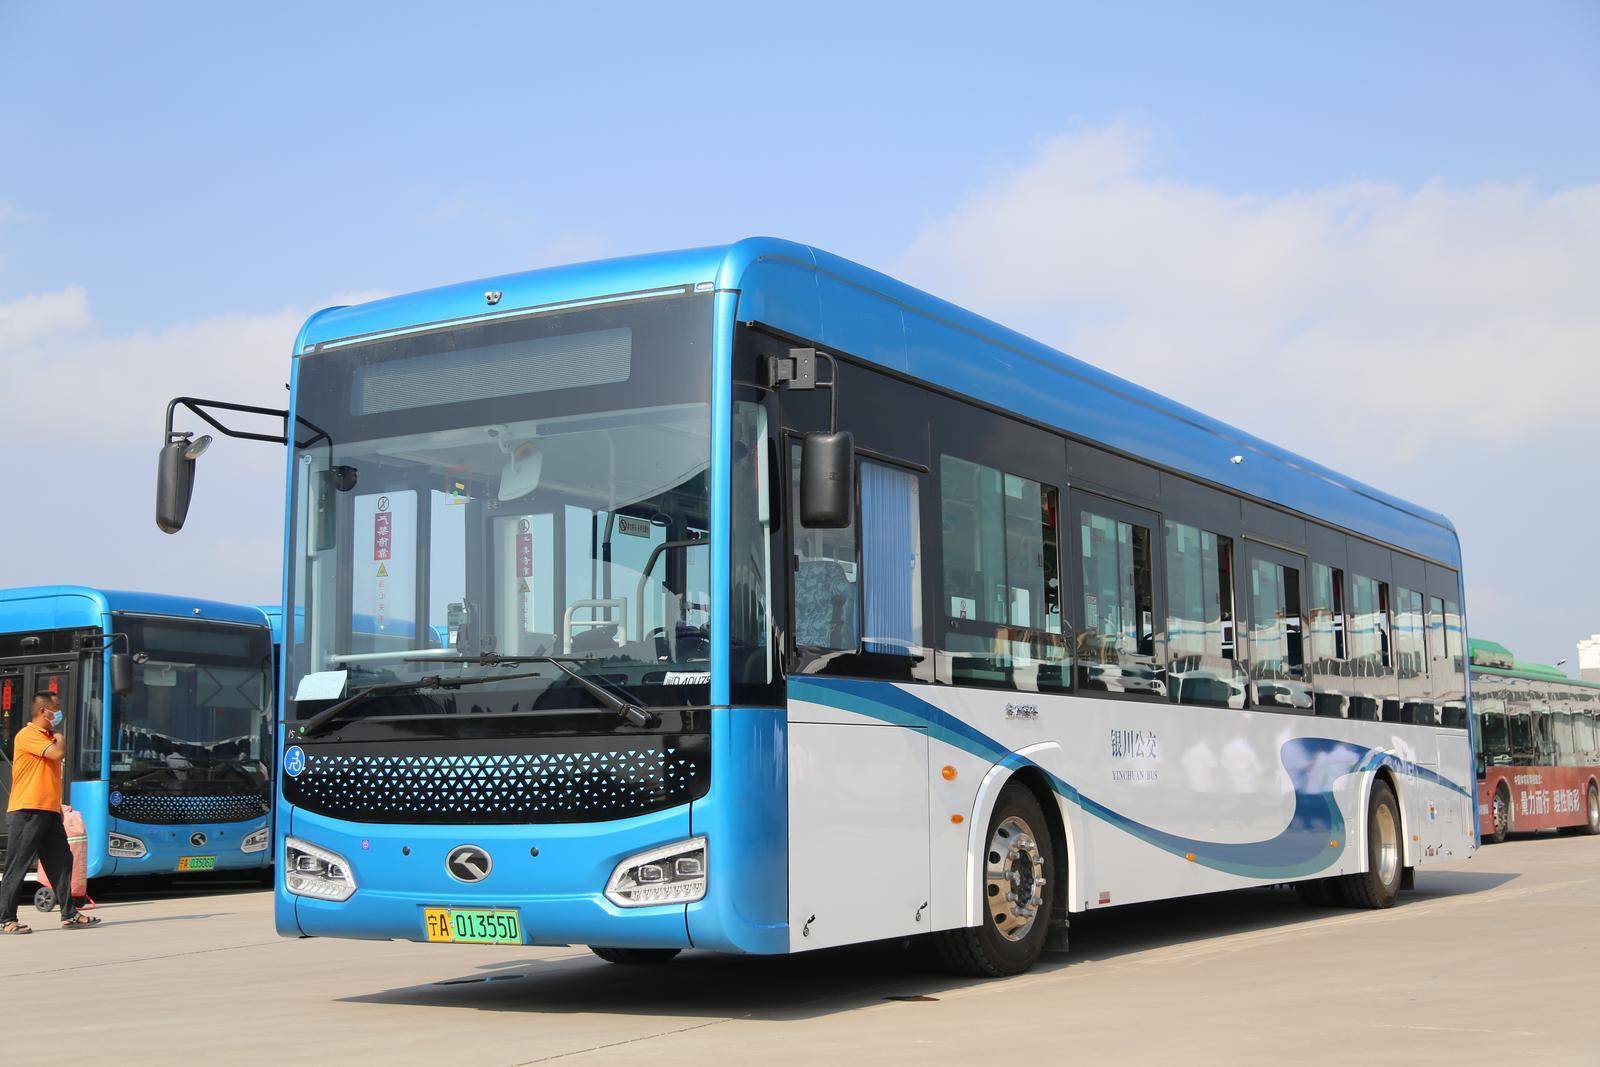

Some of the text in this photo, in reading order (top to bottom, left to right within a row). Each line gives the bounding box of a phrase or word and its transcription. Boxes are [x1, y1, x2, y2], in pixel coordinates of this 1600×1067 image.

[1111, 729, 1157, 759] 银川公交
[1112, 770, 1158, 781] YINCHUAN BUS
[1521, 790, 1550, 816] 量力而行
